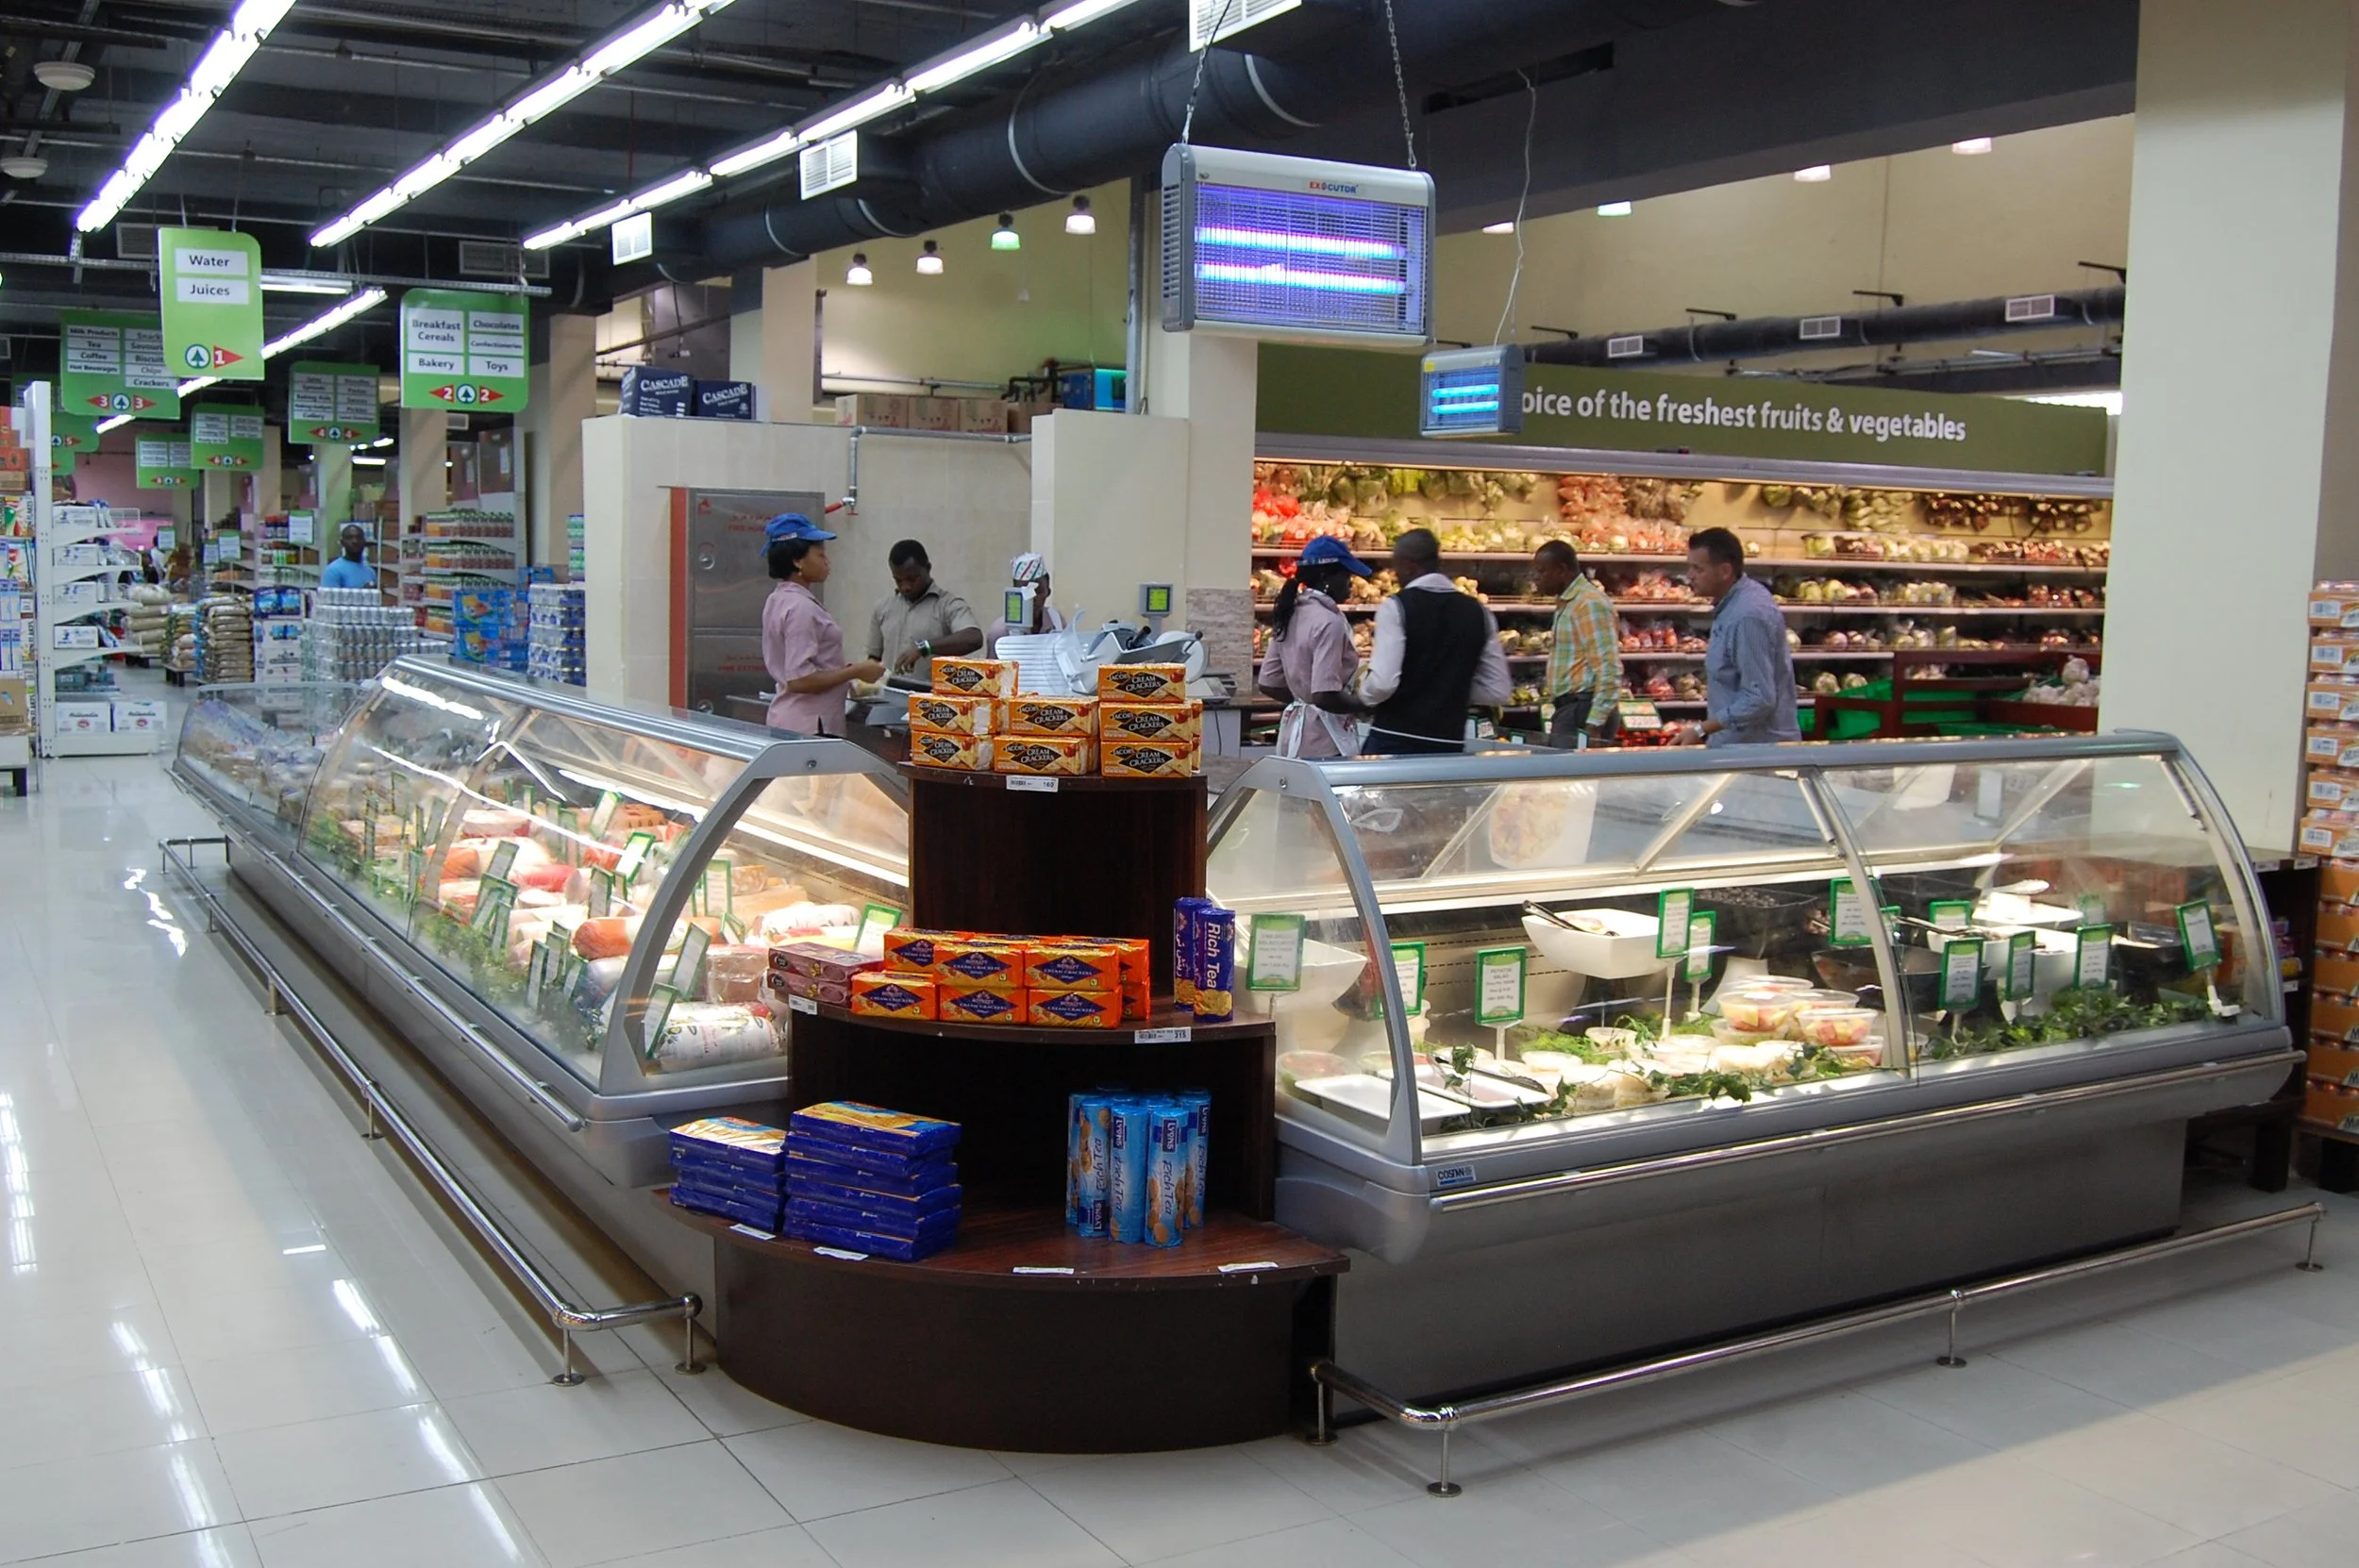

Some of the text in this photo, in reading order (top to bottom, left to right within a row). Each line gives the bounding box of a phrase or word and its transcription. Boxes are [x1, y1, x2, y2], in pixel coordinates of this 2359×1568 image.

[189, 255, 230, 267] Water
[190, 284, 229, 295] Juices
[412, 319, 460, 330] Breakfast
[473, 320, 520, 330] Chocolates
[418, 331, 455, 342] Cereals
[80, 351, 108, 359] Coffee
[135, 355, 164, 363] Biscuit
[214, 350, 225, 365] 1
[418, 358, 455, 370] Bakery
[486, 360, 509, 372] Toys
[133, 378, 170, 387] Crackers
[640, 375, 689, 392] CASCADE
[443, 387, 453, 400] 2
[480, 389, 490, 402] 2
[702, 383, 748, 404] CASCADE
[99, 395, 108, 408] 3
[135, 397, 143, 409] 3
[1521, 386, 1966, 442] oice of the freshest fruits & vegetables
[66, 437, 73, 445] 5
[1126, 682, 1161, 692] CRACKERS
[1034, 715, 1068, 724] CRACKERS
[1129, 723, 1164, 731] CRACKERS
[1021, 755, 1055, 763] CRACKERS
[1136, 751, 1161, 759] CREAM
[1129, 758, 1165, 766] CRACKERS
[1207, 922, 1221, 989] Rich Tea
[1114, 1120, 1123, 1147] LYONS
[1166, 1122, 1176, 1149] LYONS
[1093, 1138, 1105, 1193] Rich Tea
[1163, 1160, 1175, 1215] Rich Tea
[1115, 1189, 1124, 1212] Tea
